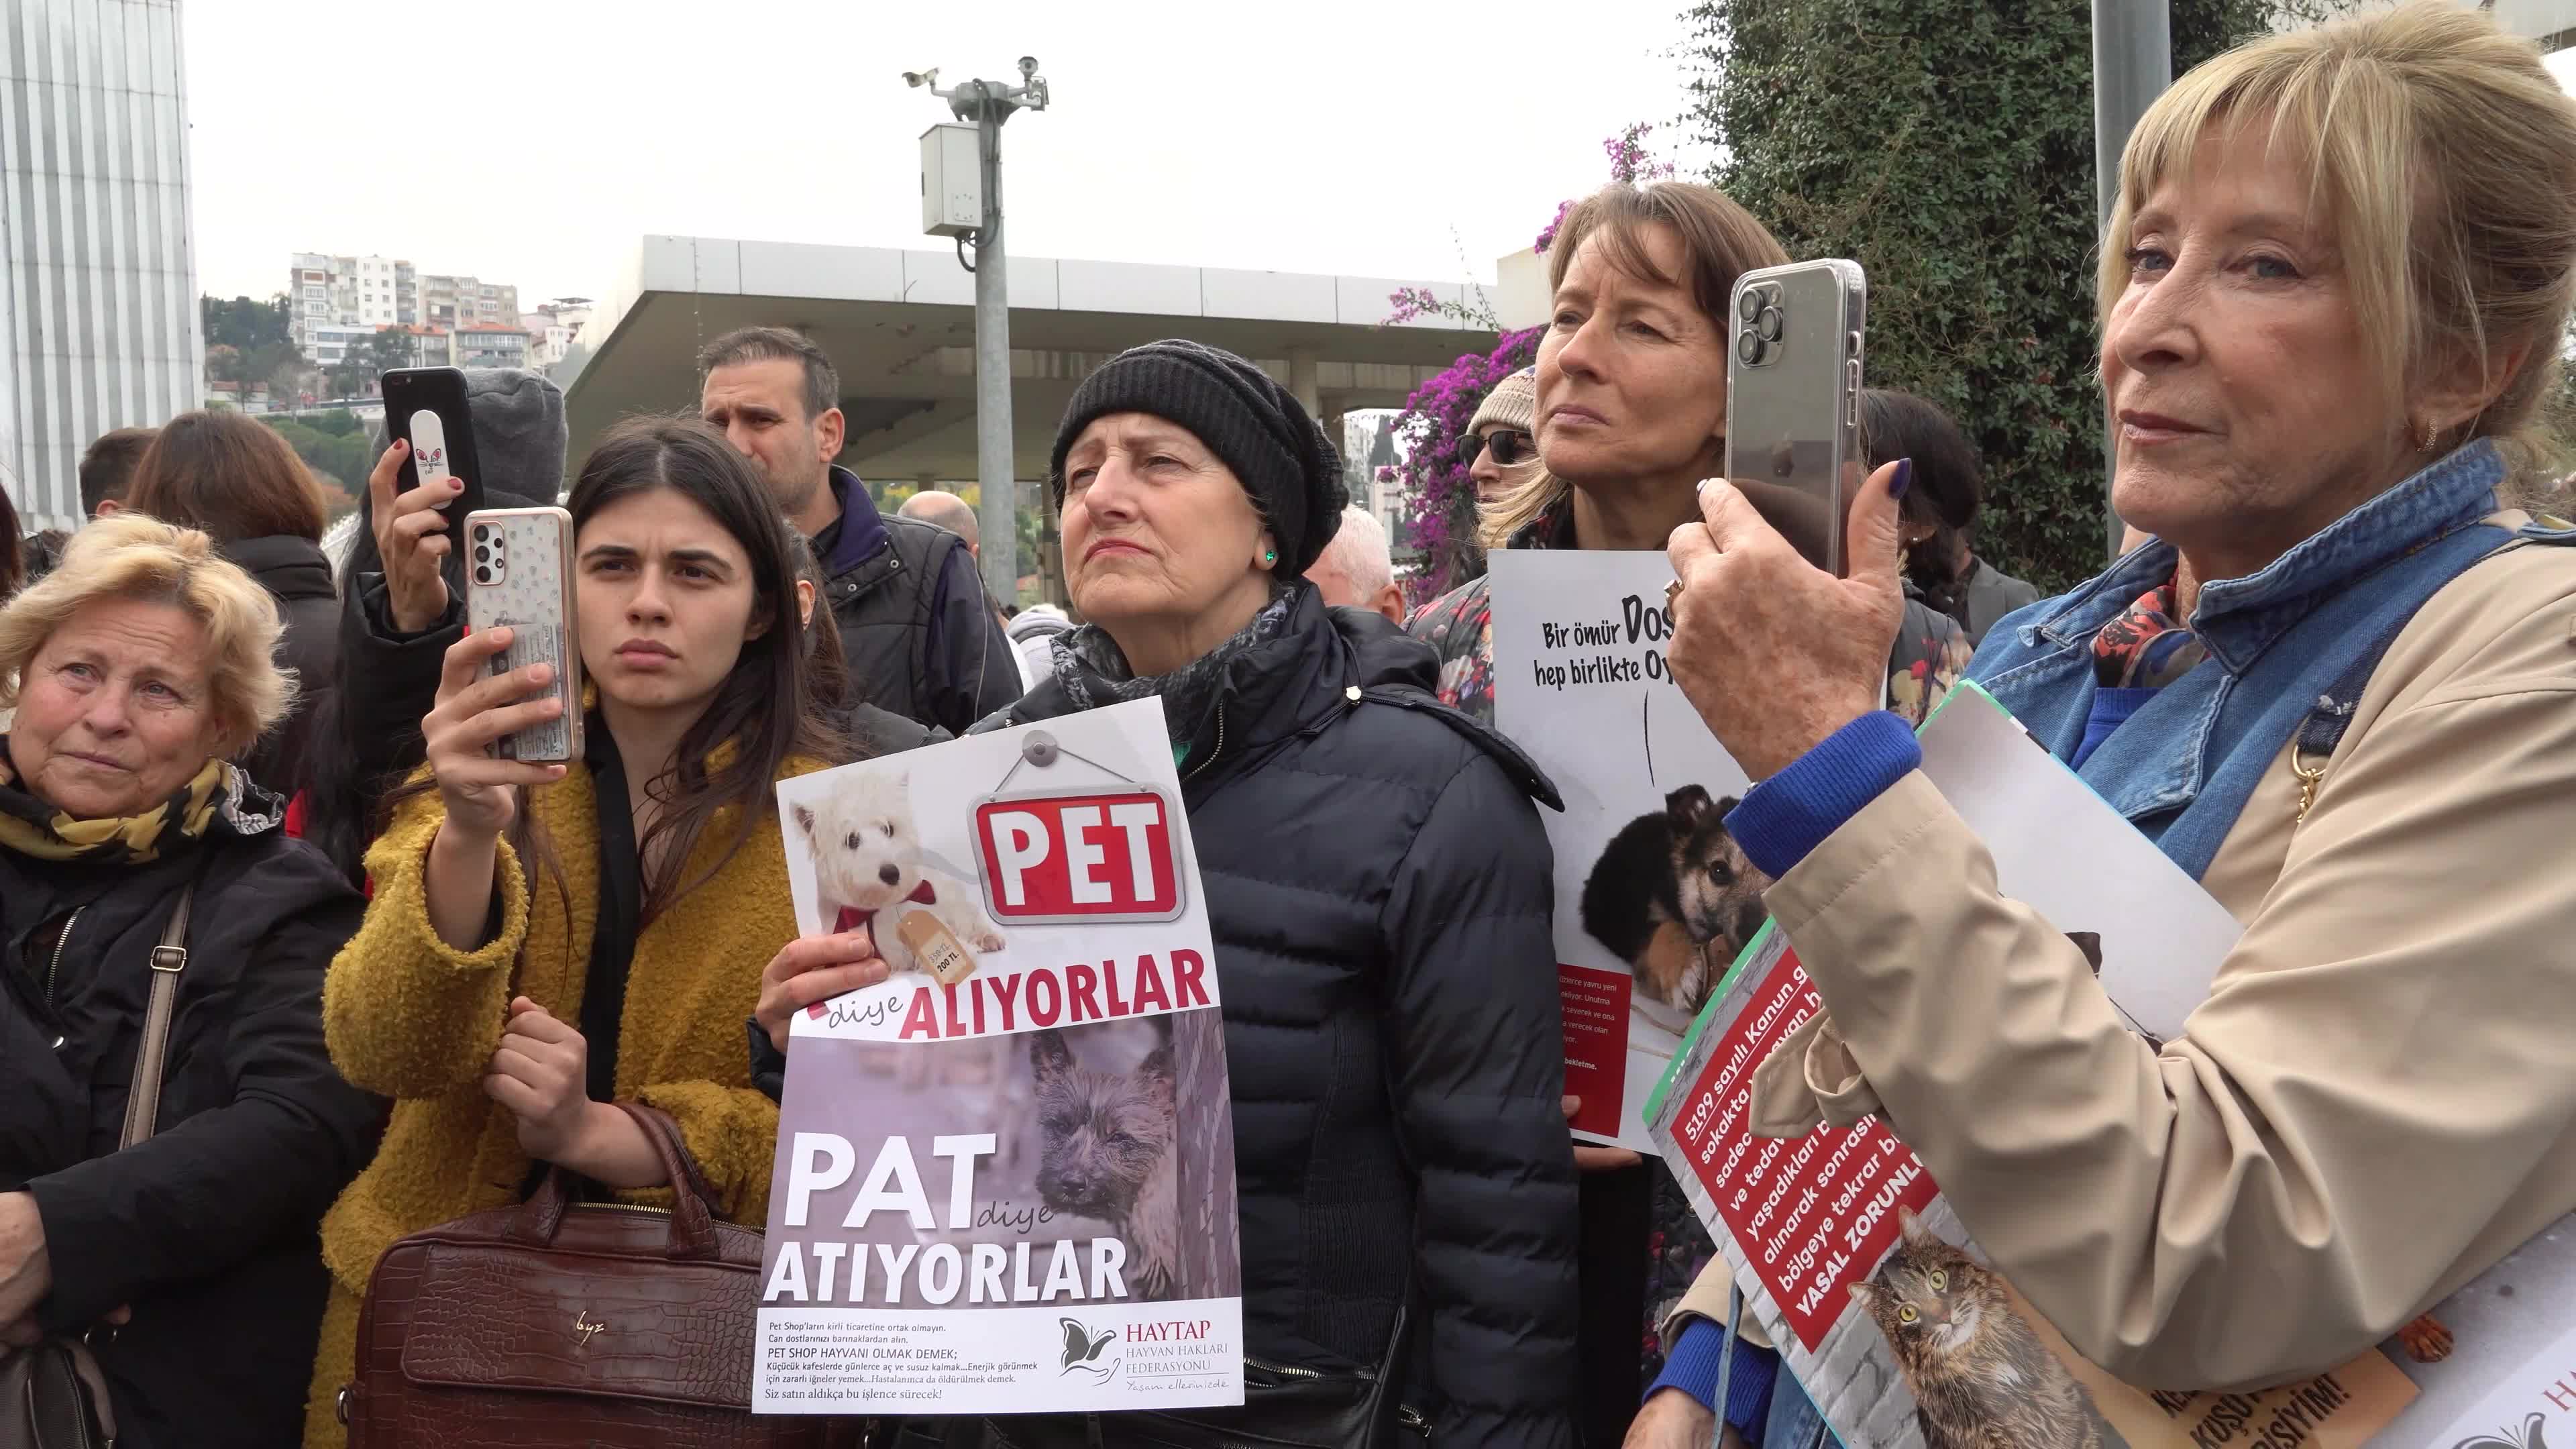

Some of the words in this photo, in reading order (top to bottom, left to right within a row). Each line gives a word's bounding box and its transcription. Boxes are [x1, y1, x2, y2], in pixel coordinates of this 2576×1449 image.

[1542, 623, 1570, 649] Bir
[1574, 620, 1621, 646] ömür
[1534, 659, 1566, 691] hep
[1570, 655, 1641, 684] birlikte
[988, 803, 1159, 906] PET
[937, 958, 950, 973] 200
[949, 952, 959, 961] TL.
[828, 996, 903, 1028] diye
[898, 949, 1210, 1040] ALIYORLAR
[1585, 995, 1610, 1005] Unutma
[1564, 1057, 1597, 1070] bekletme.
[1685, 1092, 1713, 1140] 5199
[1714, 1044, 1748, 1094] sayılı
[1745, 983, 1793, 1044] Kanun
[1701, 1088, 1750, 1164] sokakta
[783, 1132, 996, 1230] PAT
[977, 1201, 1055, 1234] diye
[1746, 1135, 1819, 1241] yaşadıkları
[1730, 1188, 1748, 1211] ve
[1764, 1186, 1819, 1264] alınarak
[1778, 1217, 1834, 1293] bölgeye
[1831, 1153, 1880, 1216] tekrar
[763, 1238, 1128, 1304] ATIYORLAR
[1796, 1250, 1850, 1317] YASAL
[577, 1310, 604, 1346] byz
[769, 1322, 781, 1330] Pet
[784, 1322, 824, 1332] Shop'ların
[827, 1322, 843, 1330] kirli
[888, 1324, 909, 1332] ortak
[912, 1324, 946, 1333] olmayın.
[769, 1334, 783, 1342] Can
[833, 1335, 888, 1343] barınaklardan
[891, 1336, 908, 1344] alın.
[1126, 1320, 1211, 1342] HAYTAP
[767, 1348, 786, 1358] PET
[789, 1348, 817, 1358] SHOP
[820, 1348, 869, 1358] HAYVANI
[873, 1348, 912, 1358] OLMAK
[916, 1349, 957, 1360] DEMEK;
[1126, 1346, 1173, 1358] HAYVAN
[1179, 1343, 1228, 1356] HAKLARI
[767, 1362, 800, 1373] Küçücük
[845, 1362, 880, 1372] günlerce
[883, 1364, 892, 1373] aç
[998, 1362, 1038, 1372] görünmek
[1126, 1360, 1210, 1373] FEDERASYONU
[766, 1375, 780, 1385] için
[809, 1375, 836, 1385] iğneler
[938, 1375, 985, 1383] öldürülmek
[987, 1375, 1016, 1383] demek.
[765, 1389, 779, 1399] Siz
[782, 1390, 805, 1399] satın
[808, 1388, 843, 1401] aldıkça
[847, 1388, 859, 1399] bu
[863, 1389, 897, 1401] işlence
[900, 1389, 942, 1399] sürecek!
